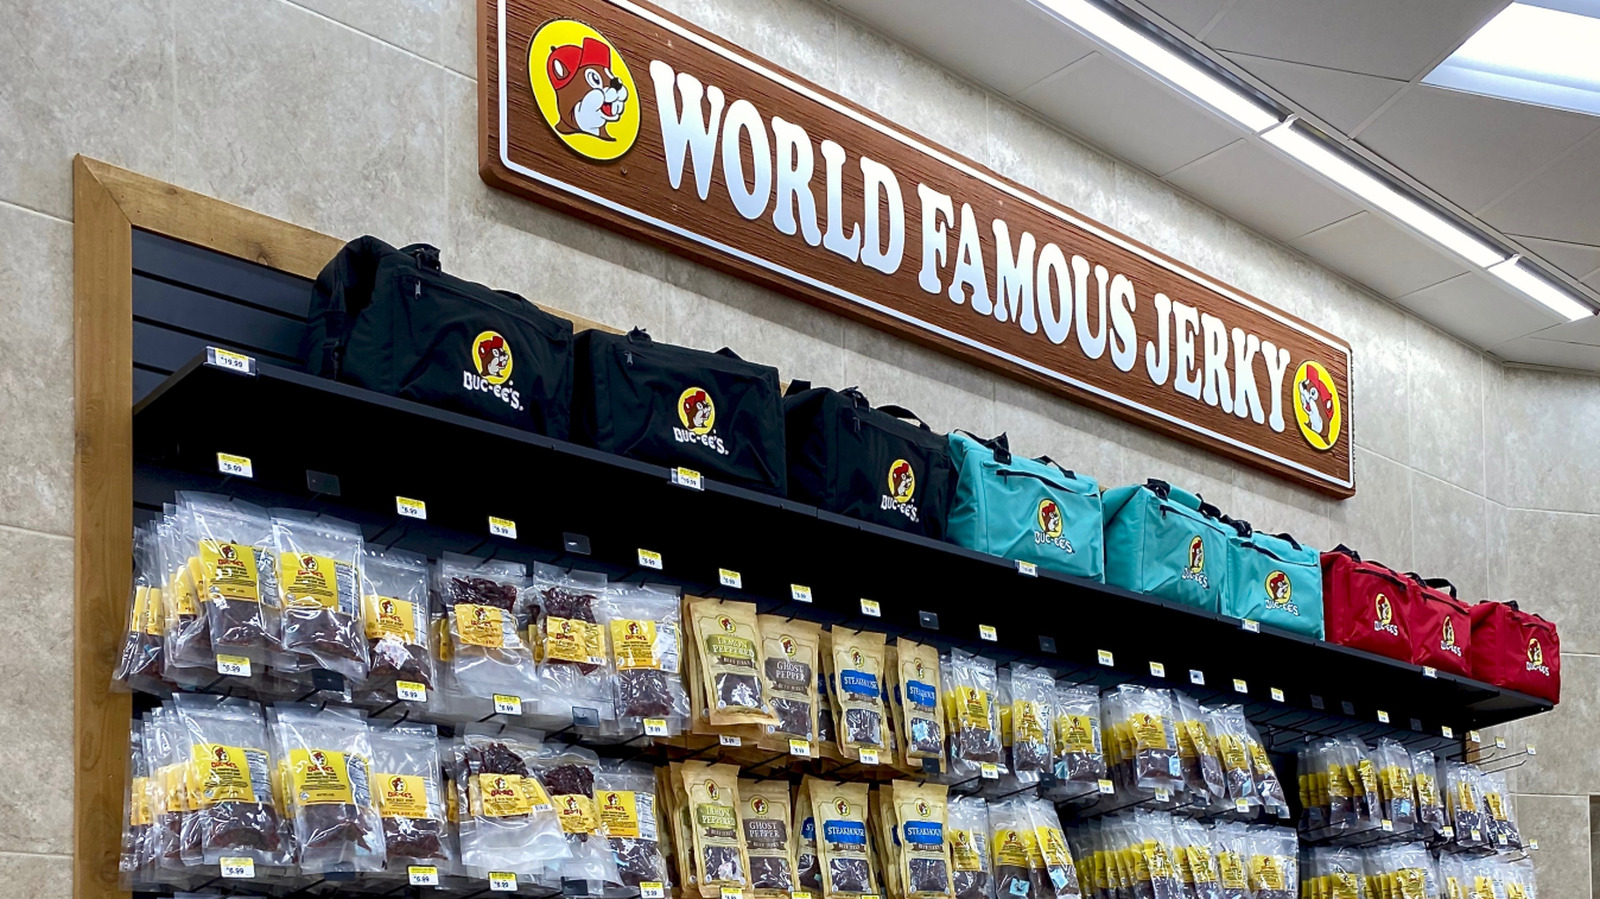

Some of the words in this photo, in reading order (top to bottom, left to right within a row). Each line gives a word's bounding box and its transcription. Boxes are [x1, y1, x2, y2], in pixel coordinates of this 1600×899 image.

[650, 60, 905, 275] WORLD
[917, 182, 1137, 373] FAMOUS
[1144, 292, 1291, 434] JERKY
[776, 661, 805, 672] GHOST
[775, 670, 806, 682] PEPPER
[749, 821, 777, 831] GHOST
[827, 826, 865, 837] STEAKHOUSE
[749, 830, 780, 838] PEPPER
